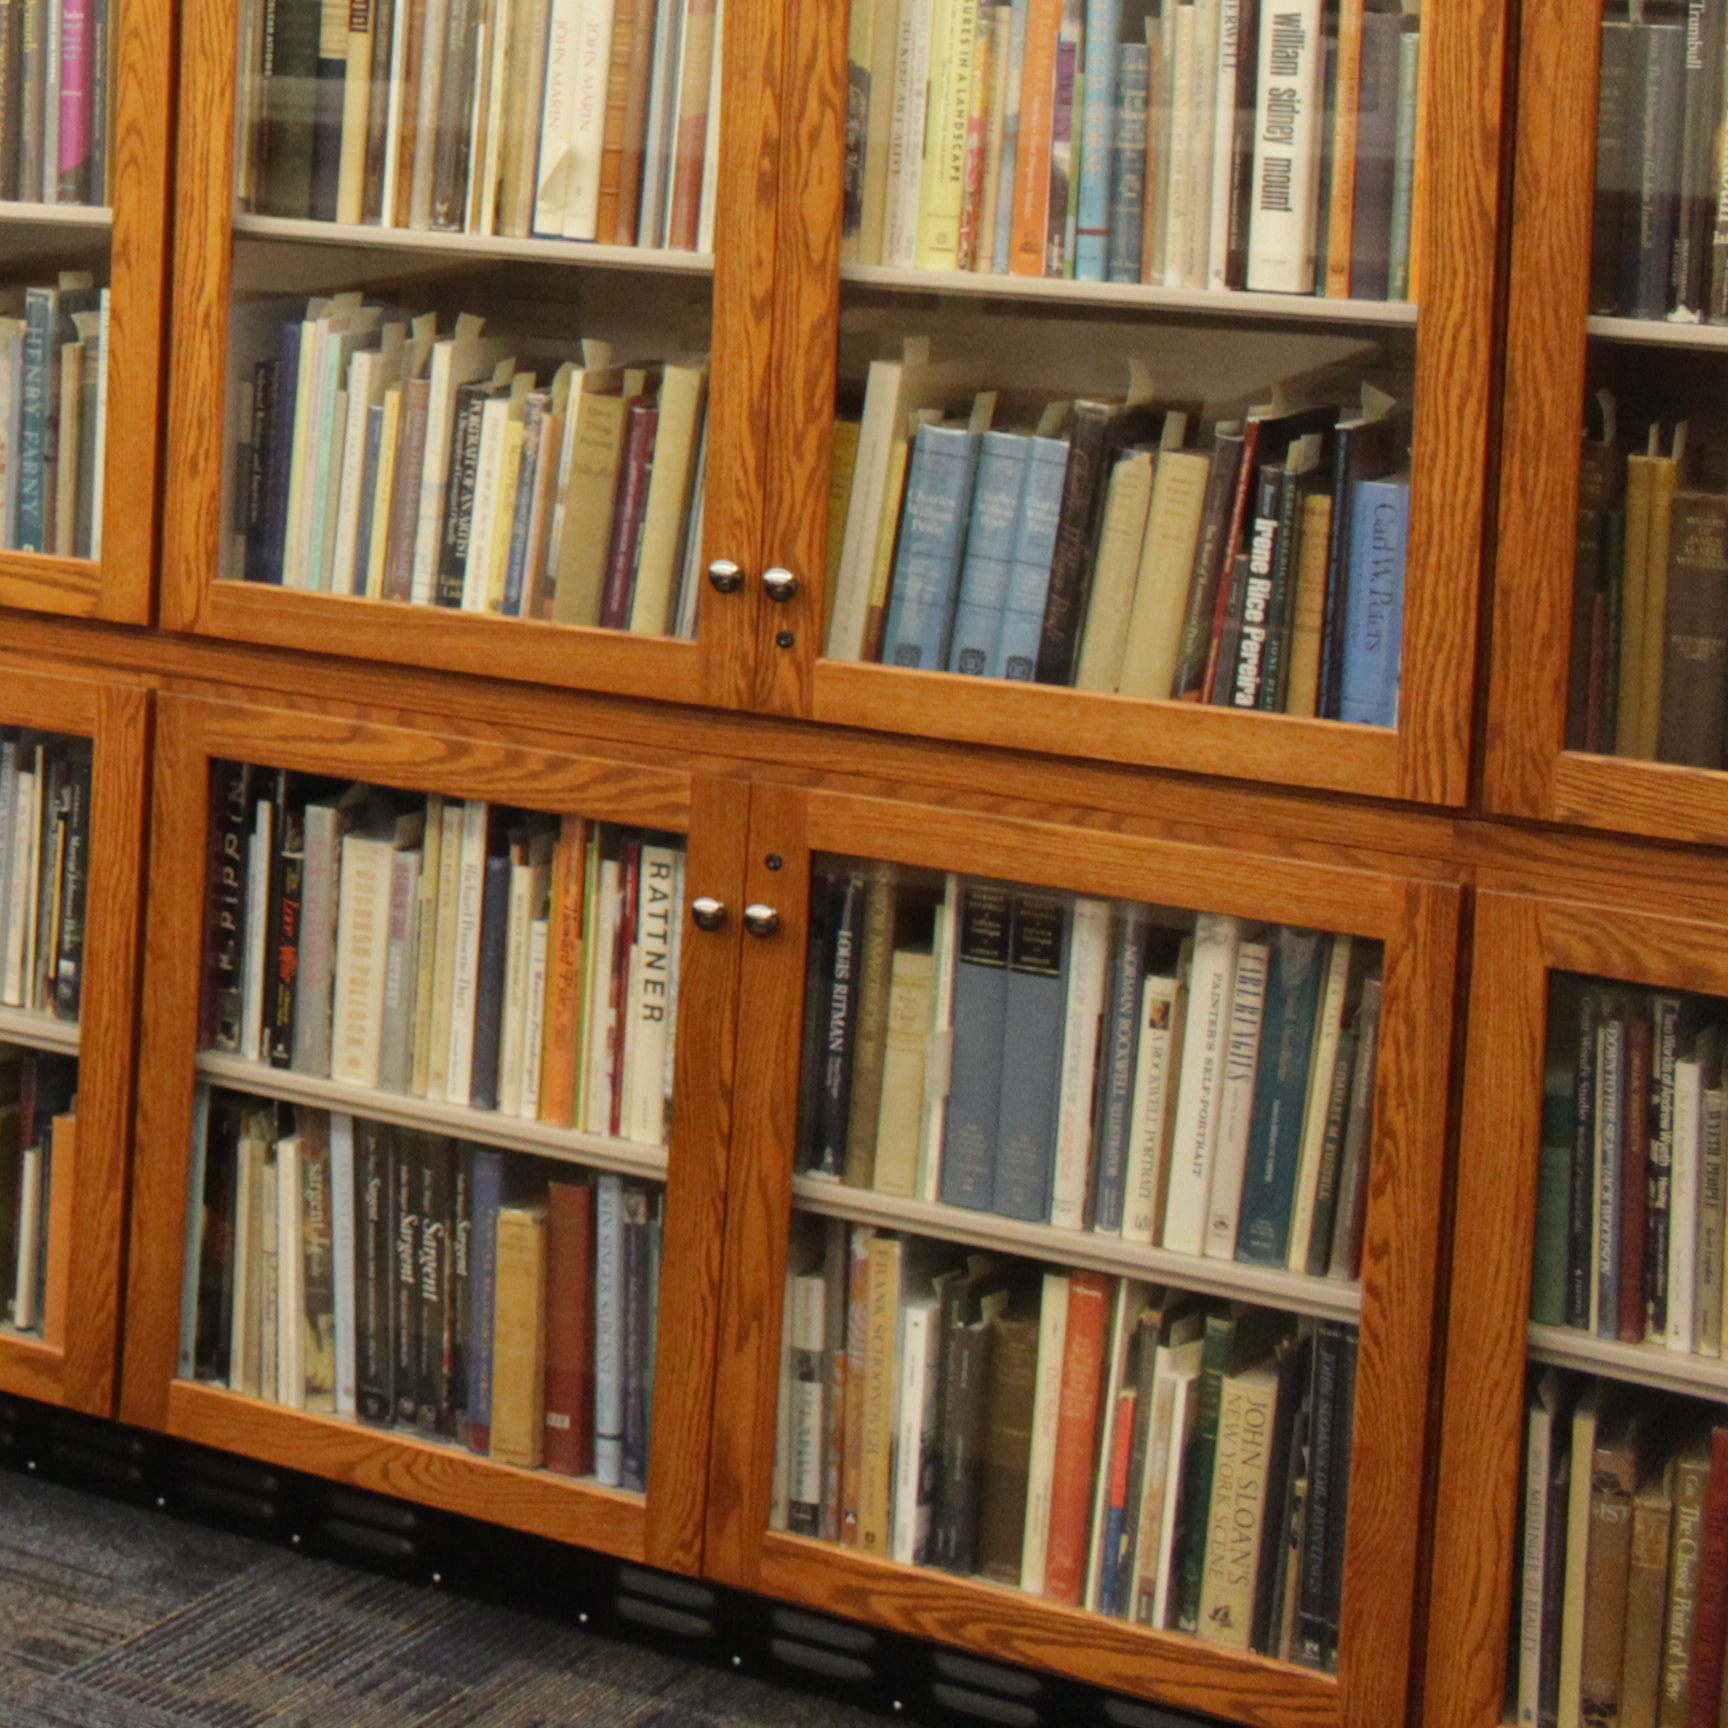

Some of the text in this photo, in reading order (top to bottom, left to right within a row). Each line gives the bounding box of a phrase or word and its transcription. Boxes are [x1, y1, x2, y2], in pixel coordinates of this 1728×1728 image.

[547, 20, 569, 129] JOHN MARIN
[578, 23, 600, 132] JOHN MARIN
[957, 73, 968, 83] A
[959, 51, 970, 69] IN
[1686, 0, 1706, 70] Trumbull
[890, 132, 903, 177] ALIVE
[949, 88, 967, 184] LANDSCAPE
[1260, 13, 1305, 213] william sidney mount
[20, 327, 44, 516] HENRY FARNY
[412, 410, 426, 448] FROM
[456, 399, 483, 560] PORTRAIT ARTIST
[908, 489, 956, 508] Charles
[912, 518, 946, 536] Peale
[1233, 517, 1279, 707] Irene Rice Pereira
[1366, 503, 1398, 652] Carl W. Peters
[281, 898, 300, 938] Love
[461, 863, 479, 917] Richard
[641, 862, 671, 1023] RATTNER
[346, 869, 376, 1048] JACKSON POLLOCK
[510, 894, 524, 1007] MAURICE PRENDERGAST
[829, 930, 852, 1052] LOUIS RITMAN
[527, 1020, 541, 1095] Prendergast
[1112, 946, 1137, 1095] NORMAN ROCKWELL
[1192, 973, 1223, 1179] PAINTER'S SELF-PORTRAIT
[1138, 1046, 1163, 1201] ROCKWELL PORTRAIT
[1318, 1060, 1349, 1200] CHARLES RUSSELL
[1577, 1081, 1589, 1120] Studio
[1600, 1028, 1618, 1275] DOWN TO WOODSON
[1657, 1034, 1675, 1167] Worlds Andrew Wyeth
[306, 1162, 325, 1229] sargent
[366, 1178, 381, 1221] Sargent
[1704, 1161, 1720, 1211] PEOPLE
[396, 1212, 419, 1284] Sargent
[418, 1218, 445, 1302] Sargent
[454, 1219, 471, 1277] Sargent
[599, 1234, 613, 1374] SINGER SARGENT
[865, 1248, 890, 1455] FRANK SCHOONOVER
[1209, 1392, 1243, 1580] NEW YORK SCENE
[1228, 1396, 1269, 1588] JOHN SLOAN'S
[1306, 1351, 1336, 1593] JOHN SLOAN'S OIL PAINTINGS
[1523, 1489, 1543, 1656] MESSENGER BEAUTY
[1665, 1475, 1701, 1703] Cox The Classic Point of View
